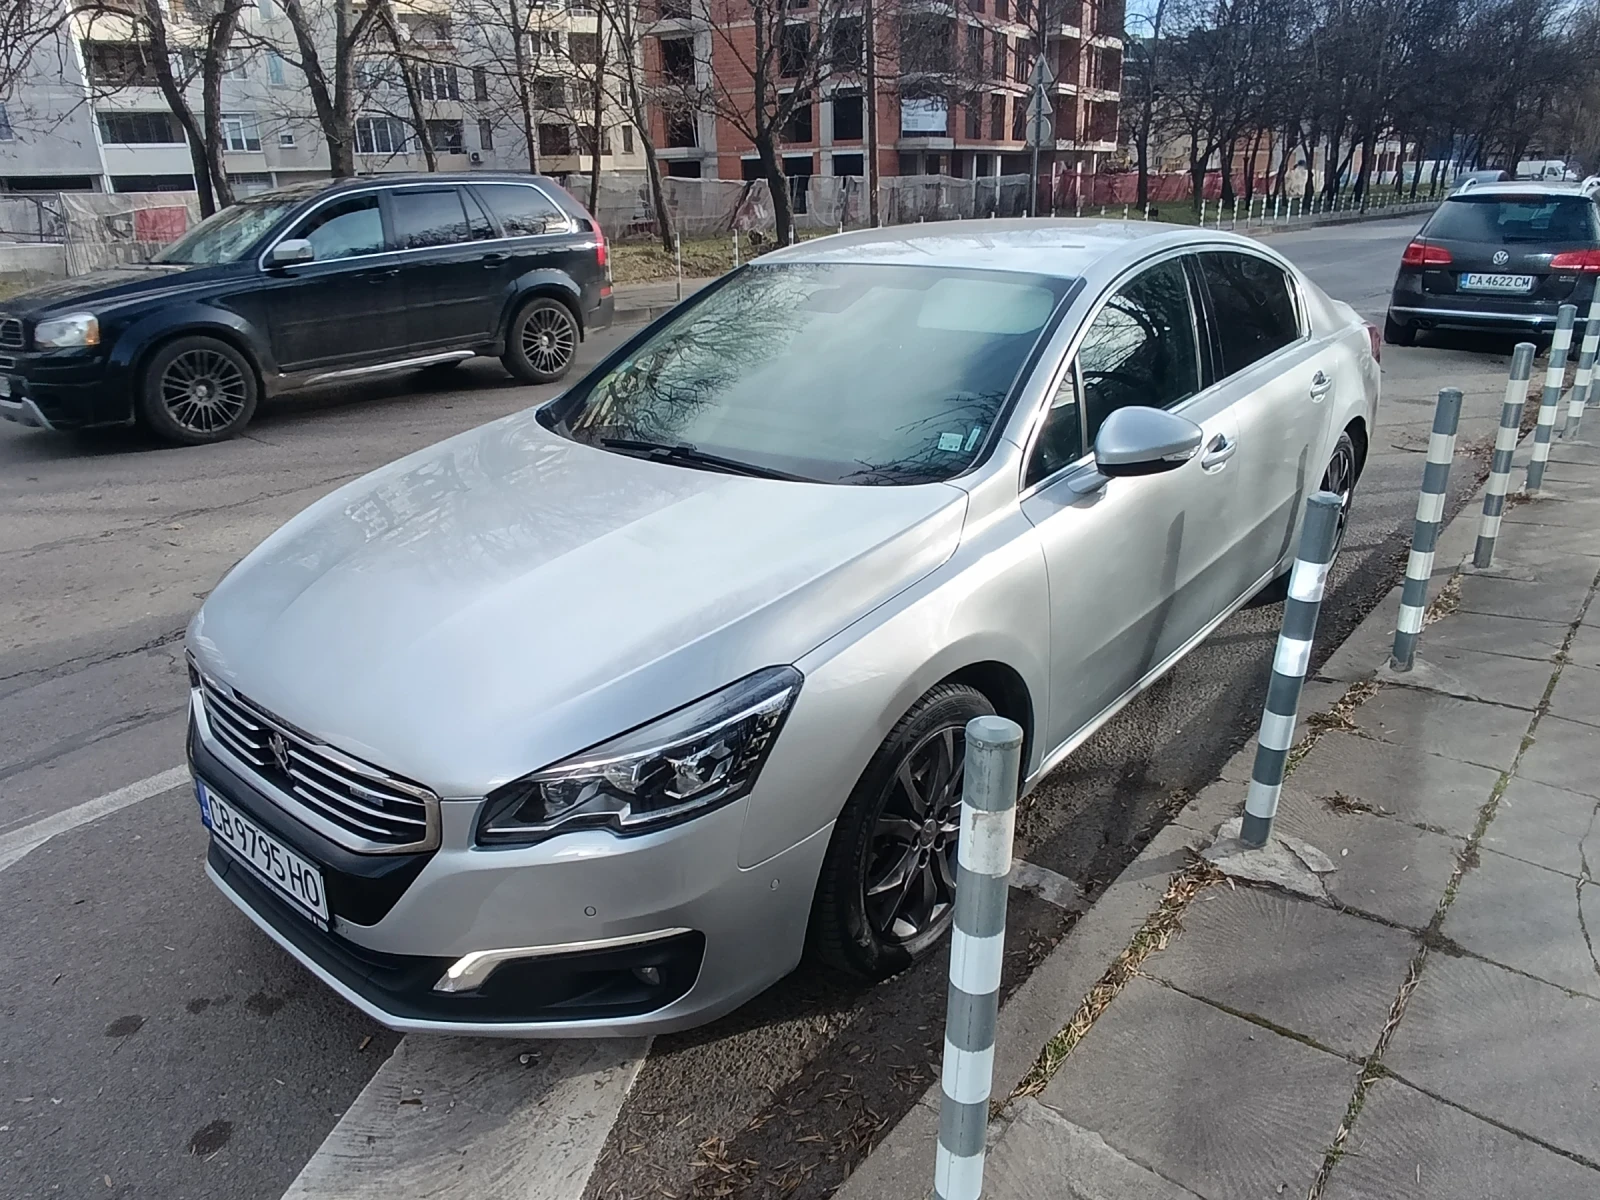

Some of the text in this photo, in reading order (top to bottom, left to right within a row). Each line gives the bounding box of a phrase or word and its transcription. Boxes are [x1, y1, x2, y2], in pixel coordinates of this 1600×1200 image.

[1468, 275, 1483, 286] CA
[1485, 276, 1513, 287] 4622
[1514, 277, 1531, 288] CM
[208, 795, 234, 841] CB
[234, 817, 286, 881] 9795
[286, 855, 320, 907] HO
